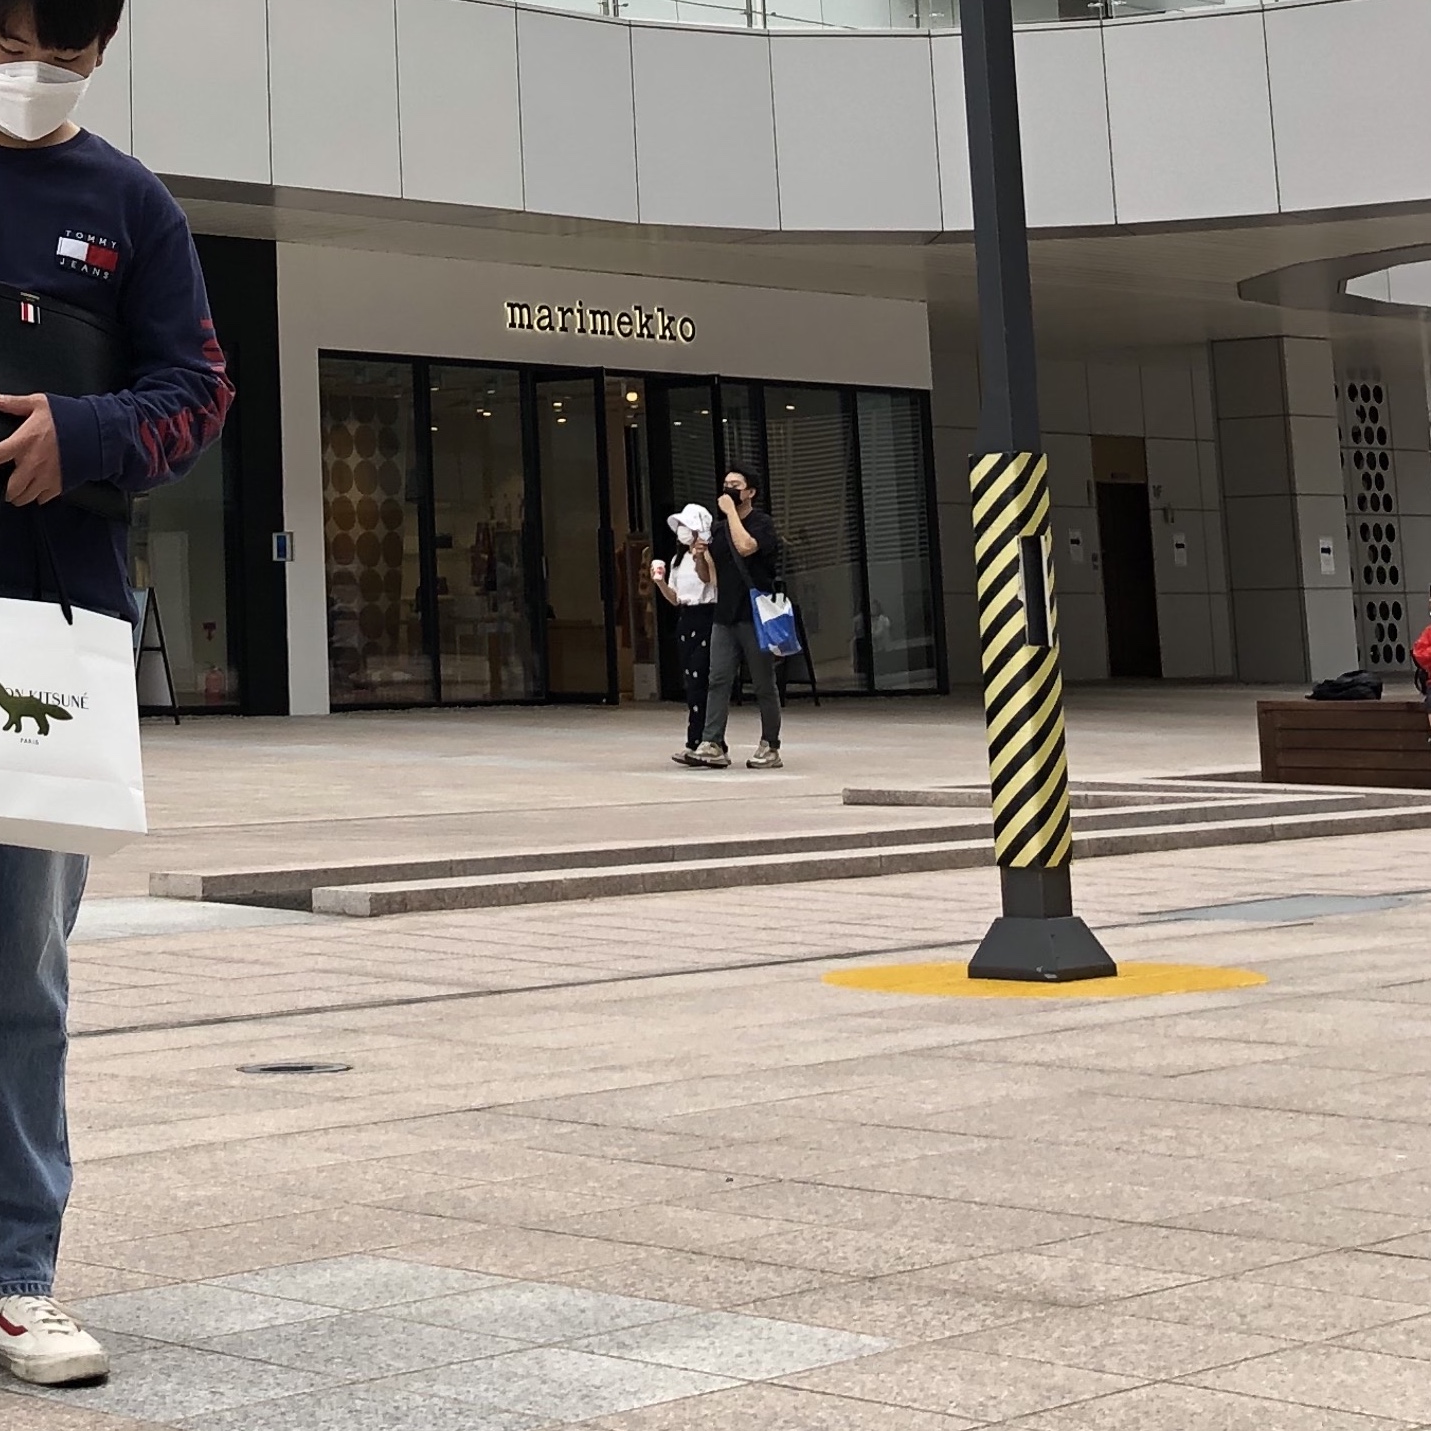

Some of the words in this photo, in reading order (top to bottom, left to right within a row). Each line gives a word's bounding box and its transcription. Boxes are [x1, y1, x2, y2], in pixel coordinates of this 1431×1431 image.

[65, 229, 117, 249] TOMMY
[59, 257, 109, 280] JEANS
[505, 300, 696, 342] marimekko
[20, 737, 39, 746] PARIS
